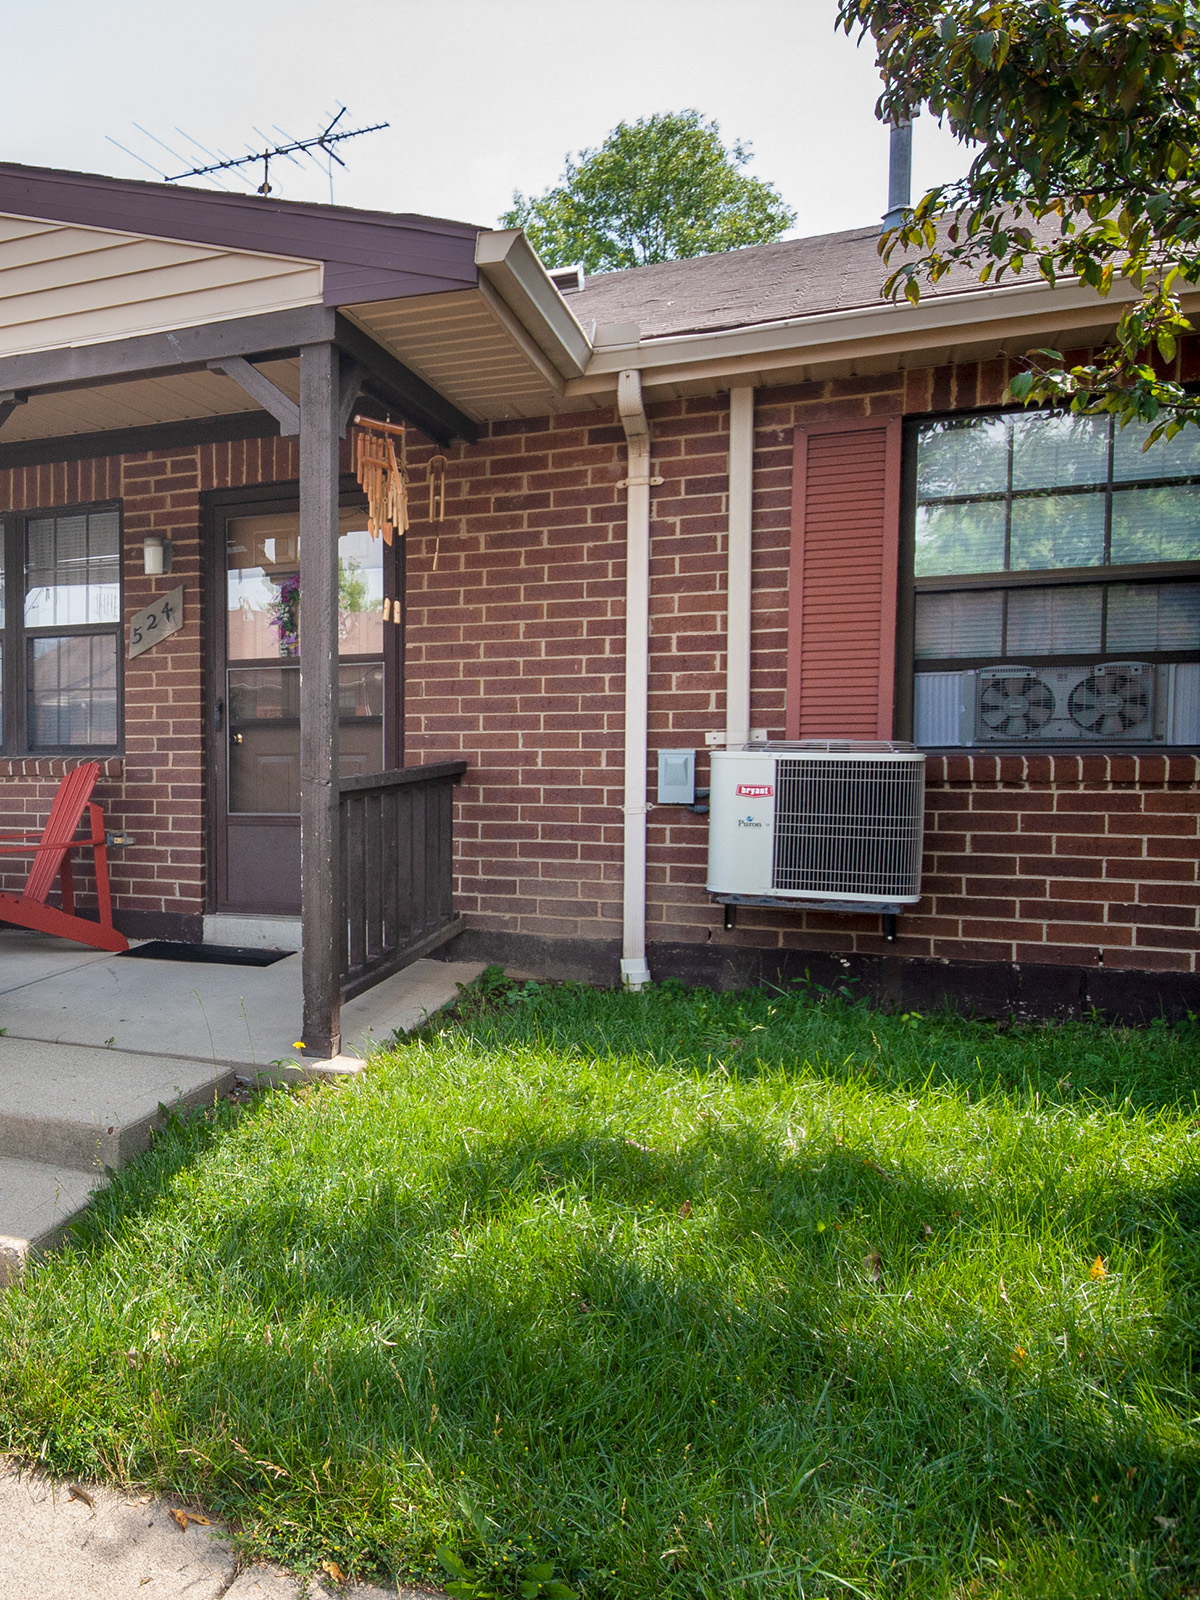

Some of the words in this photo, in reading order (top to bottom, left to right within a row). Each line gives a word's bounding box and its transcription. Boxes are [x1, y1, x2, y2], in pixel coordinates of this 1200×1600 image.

[132, 602, 173, 644] 524
[741, 787, 769, 795] bryant
[738, 820, 762, 828] Puron
